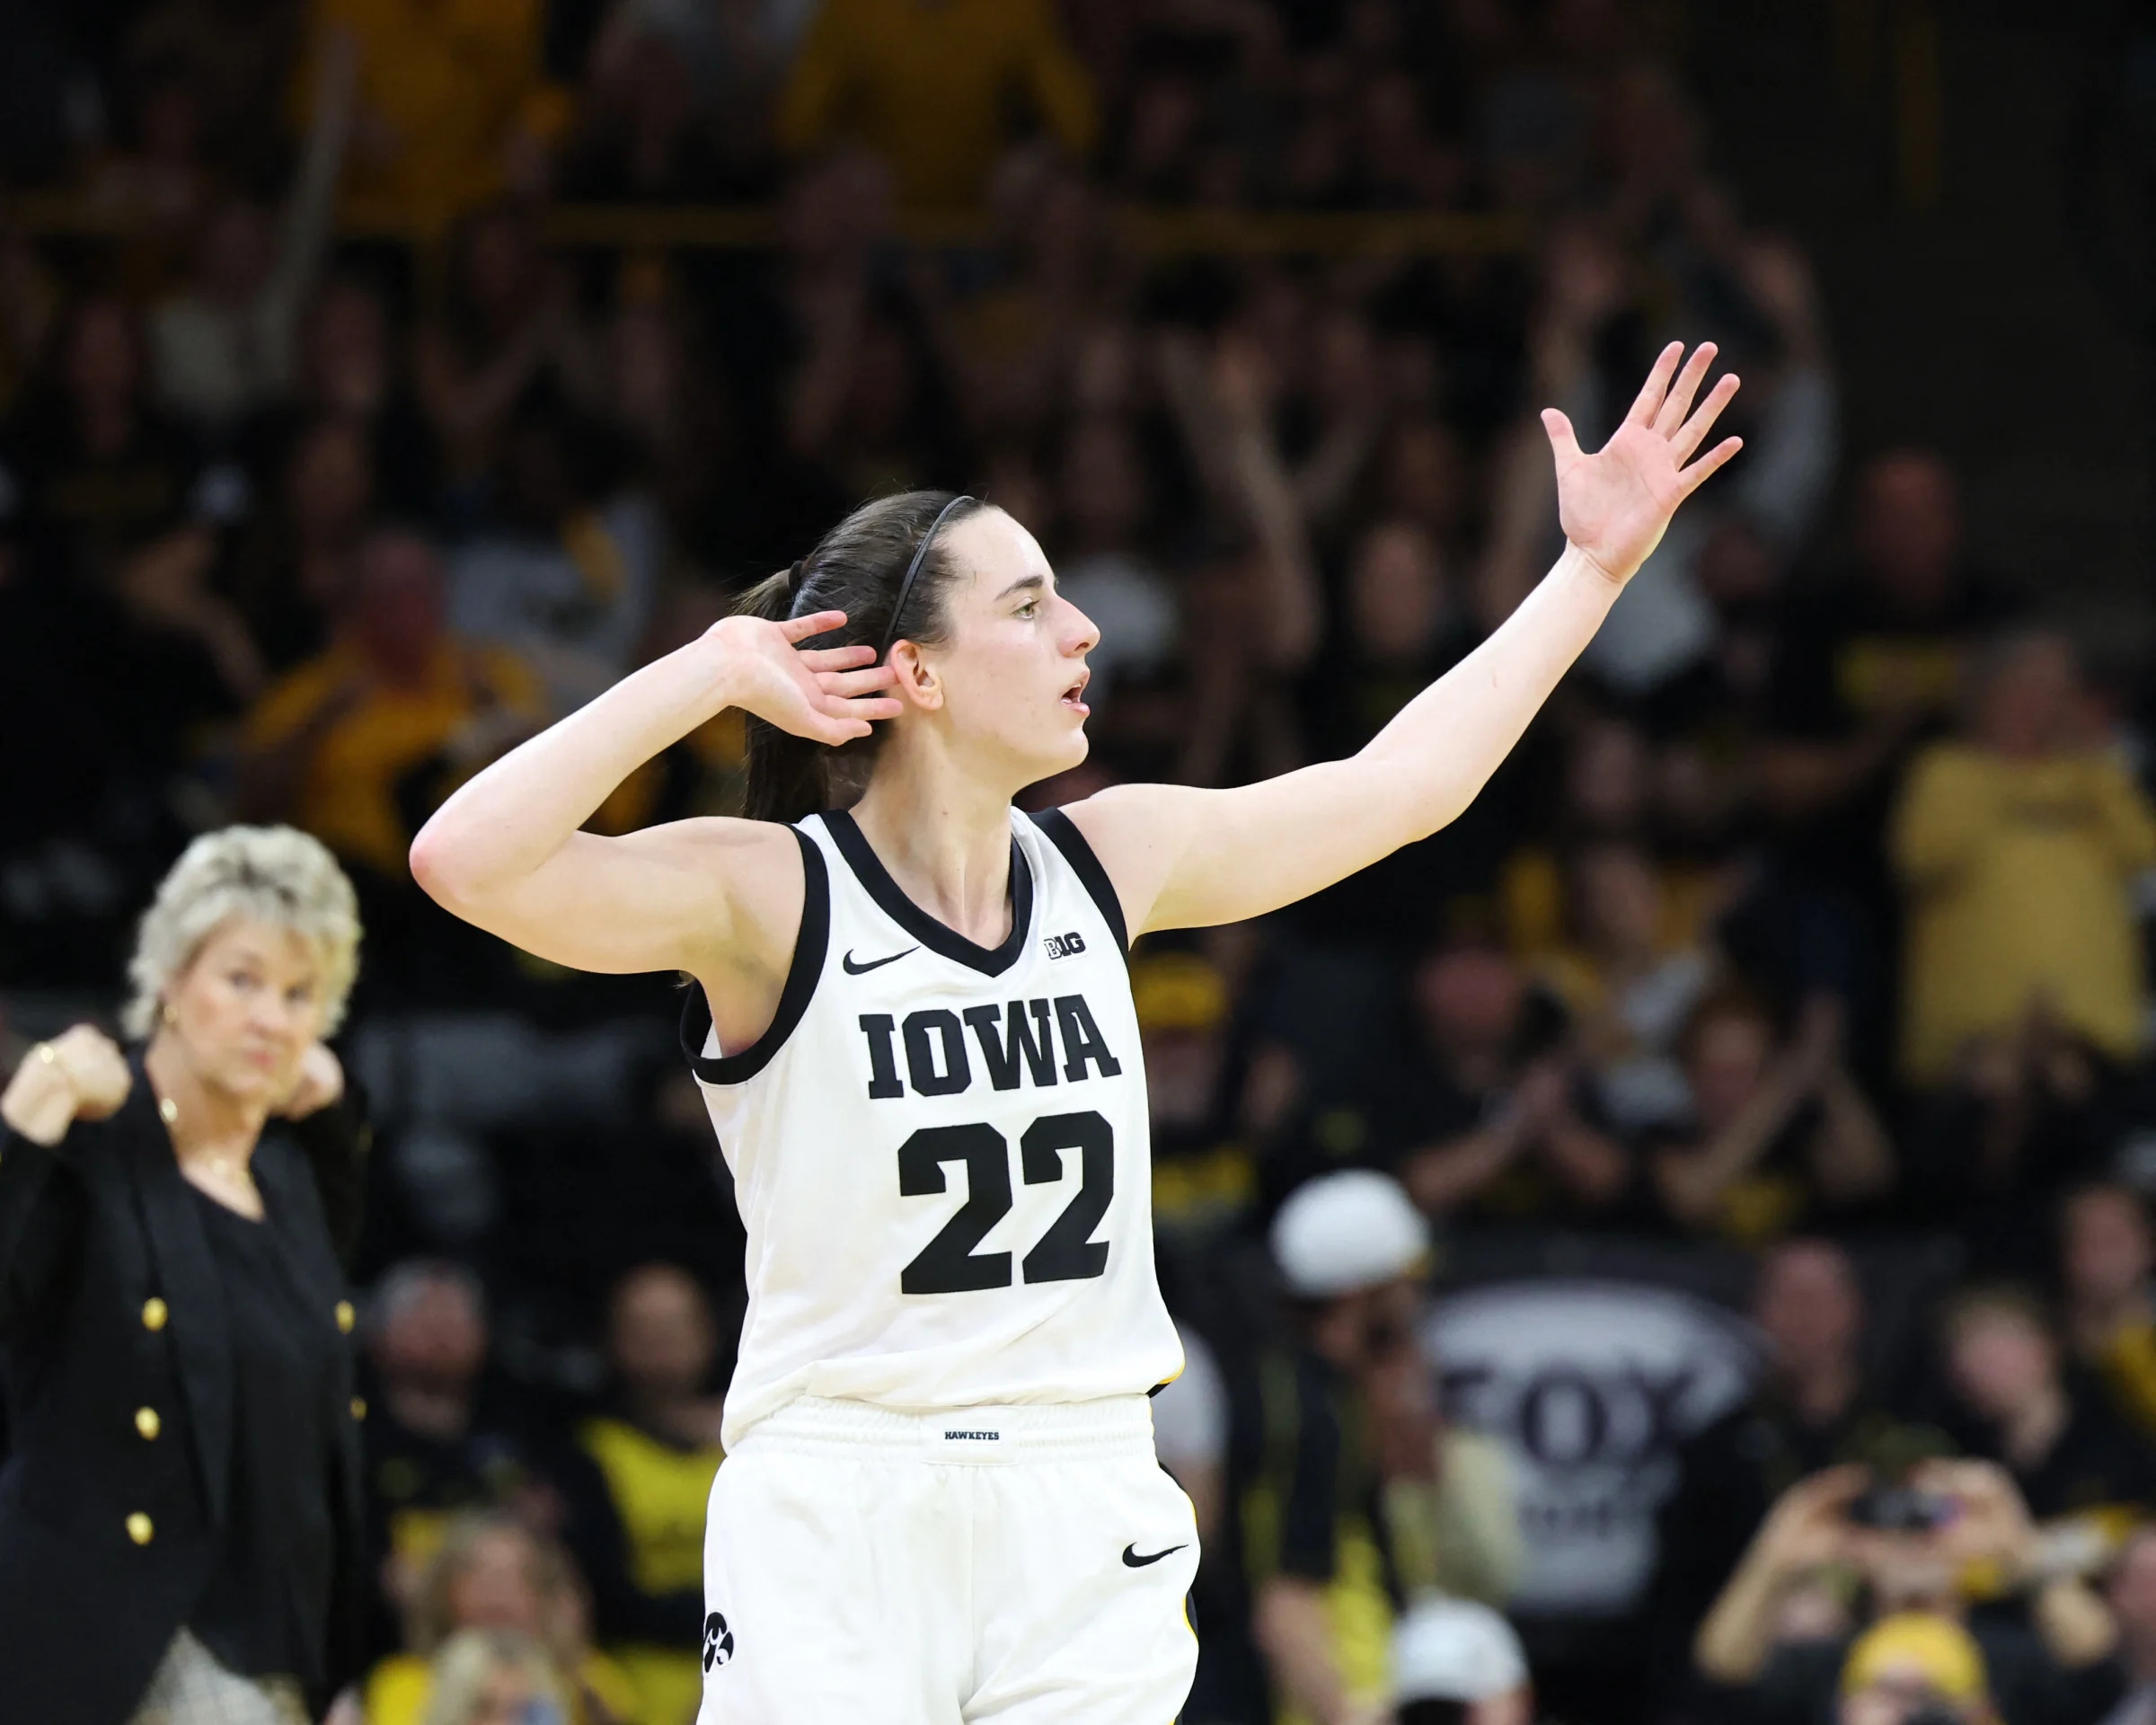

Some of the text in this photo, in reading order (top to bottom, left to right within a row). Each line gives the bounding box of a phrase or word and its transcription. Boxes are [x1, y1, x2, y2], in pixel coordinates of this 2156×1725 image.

[859, 994, 1122, 1099] IOWA
[897, 1110, 1114, 1294] 22
[944, 1431, 1000, 1440] HAWKEYES
